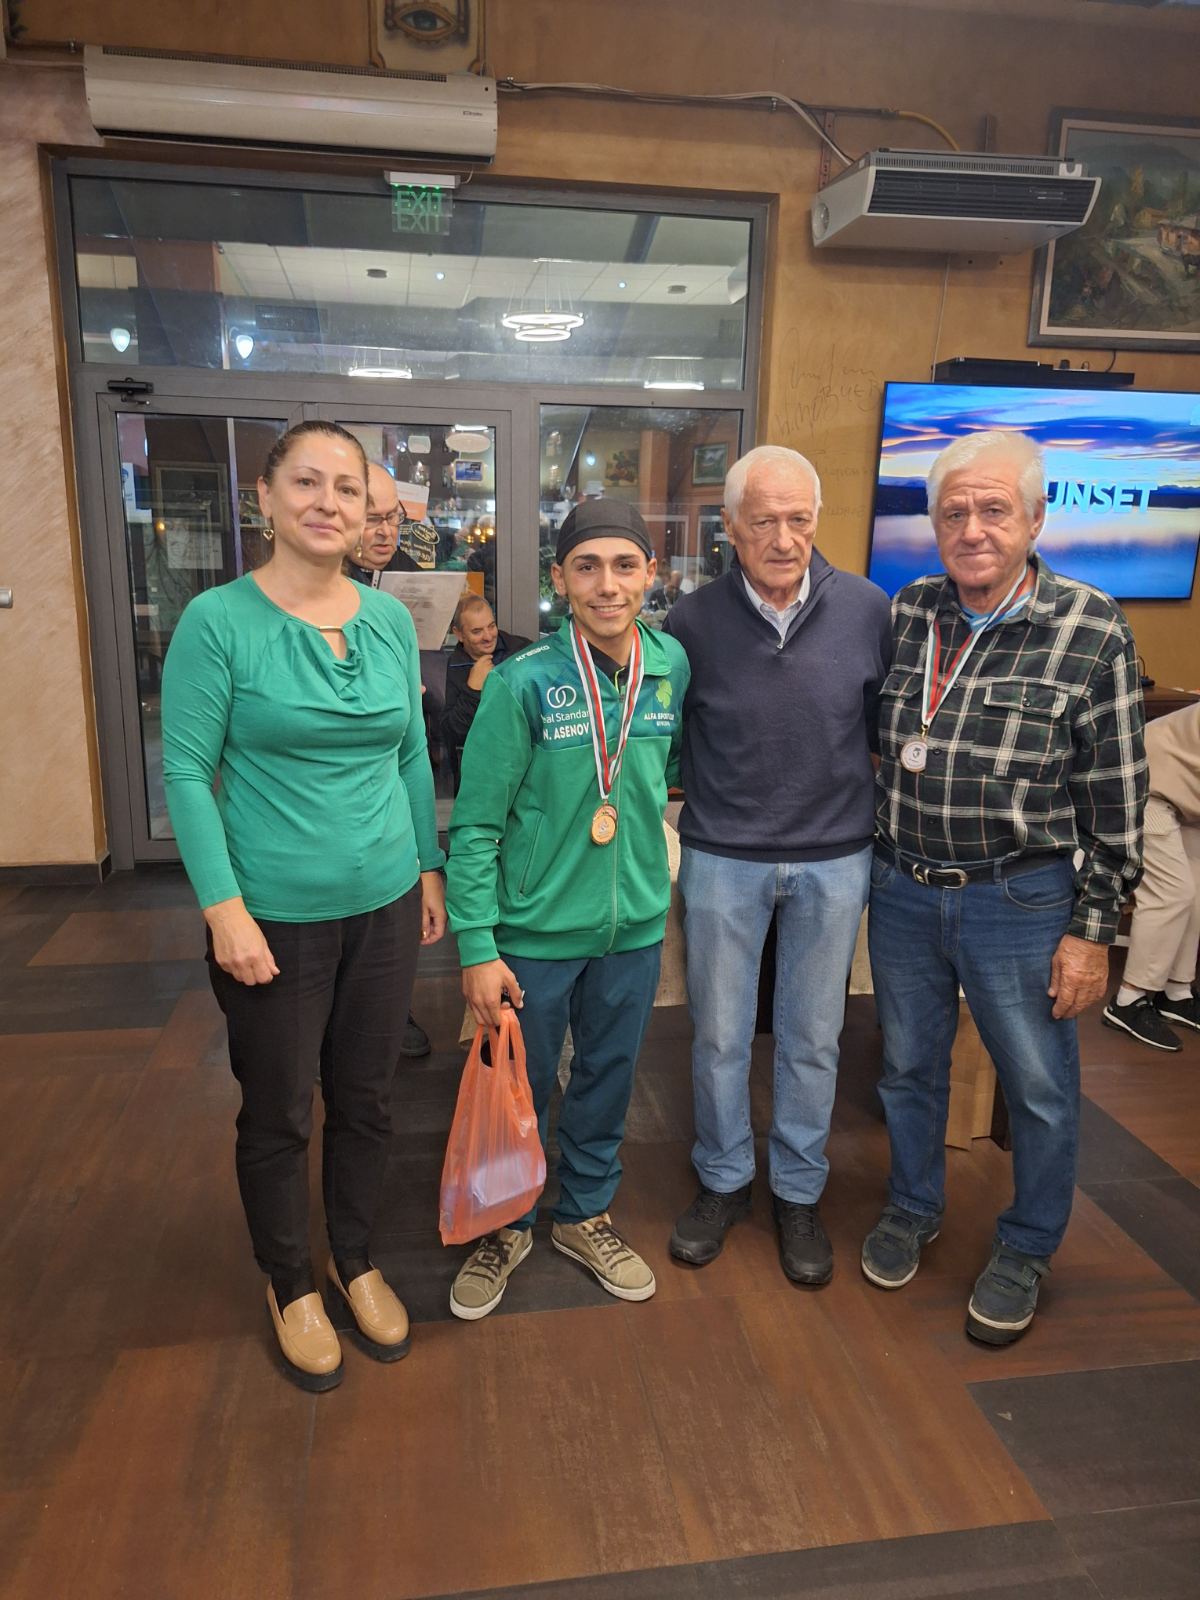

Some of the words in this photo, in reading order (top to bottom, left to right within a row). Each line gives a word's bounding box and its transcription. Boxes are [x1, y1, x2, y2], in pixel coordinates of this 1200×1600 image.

[397, 190, 446, 213] EXIT
[397, 213, 441, 233] EXIT
[1045, 480, 1159, 513] UNSET
[555, 708, 590, 722] Standar
[644, 712, 657, 721] ALFA
[543, 728, 552, 741] N.
[554, 722, 590, 740] ASENOV
